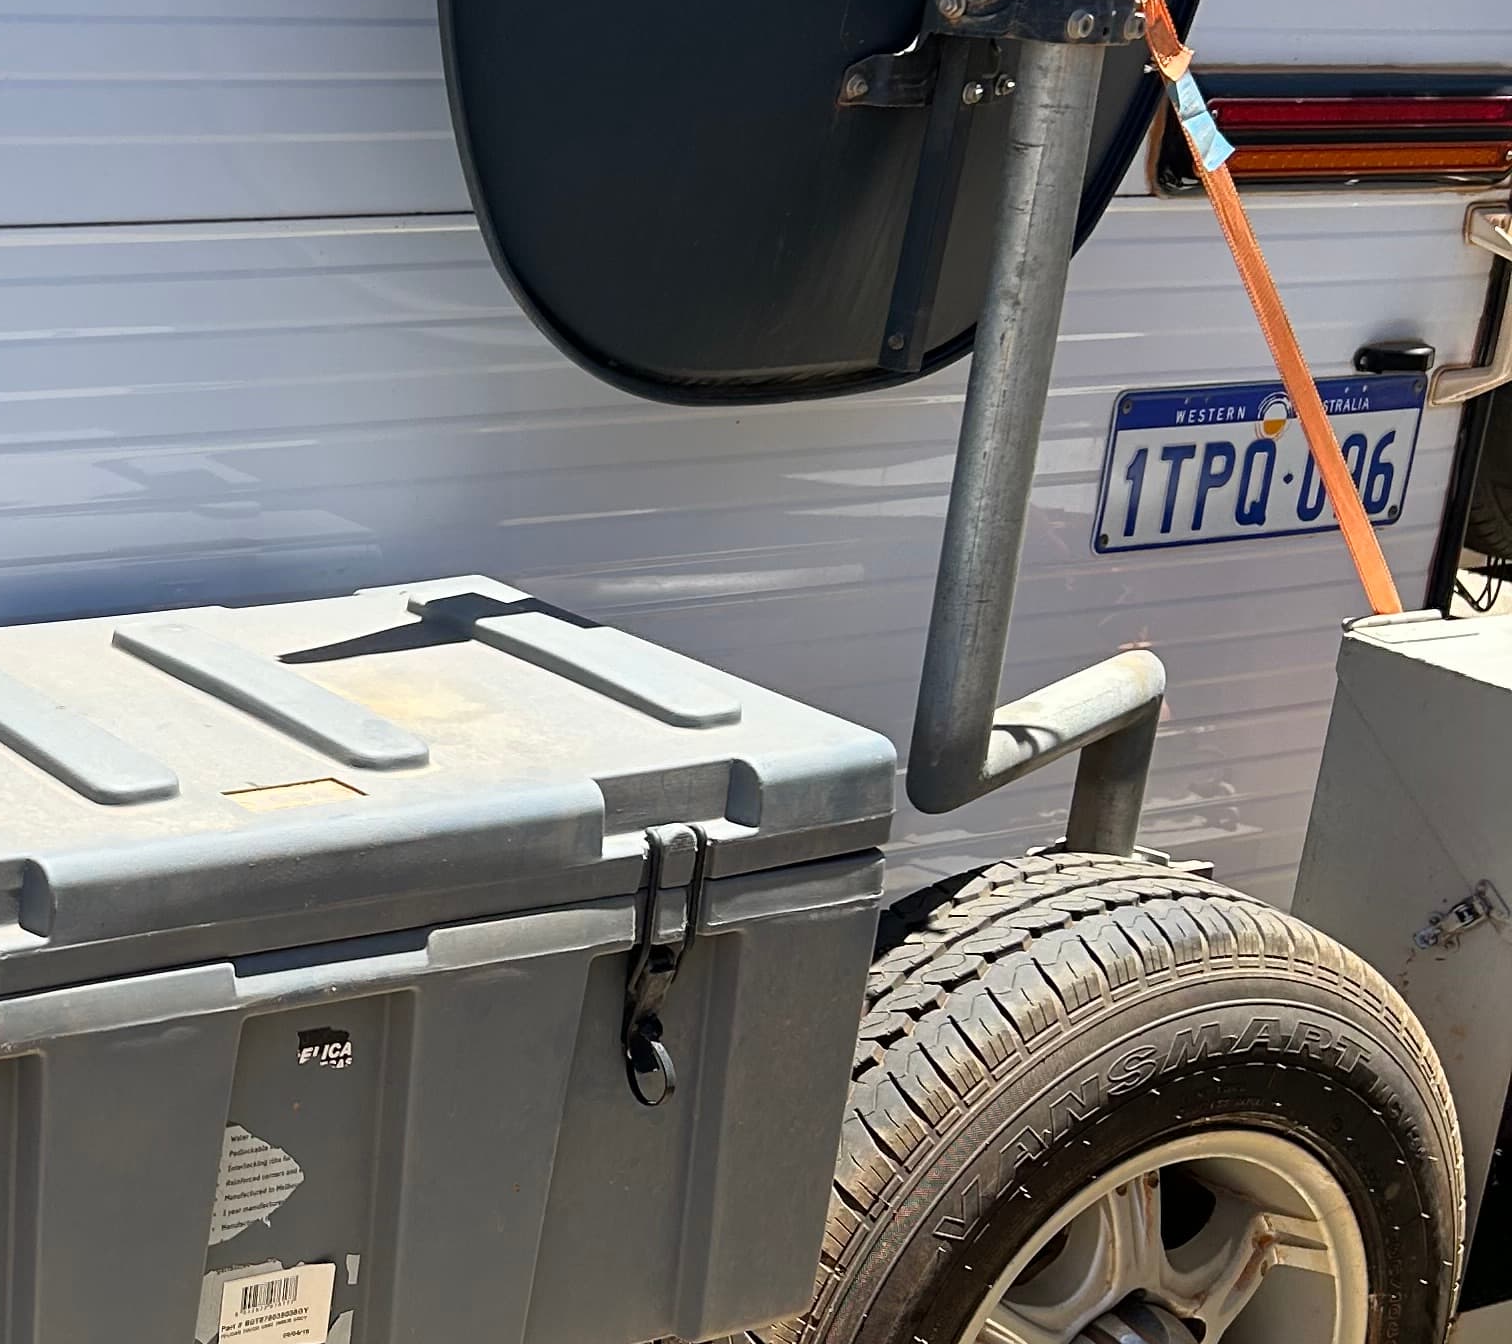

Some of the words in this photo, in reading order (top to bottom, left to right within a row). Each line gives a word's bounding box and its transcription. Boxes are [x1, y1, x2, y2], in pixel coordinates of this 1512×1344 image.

[1175, 405, 1247, 425] WESTERN
[1323, 397, 1371, 415] STRALIA
[933, 1016, 1376, 1240] VANSMART
